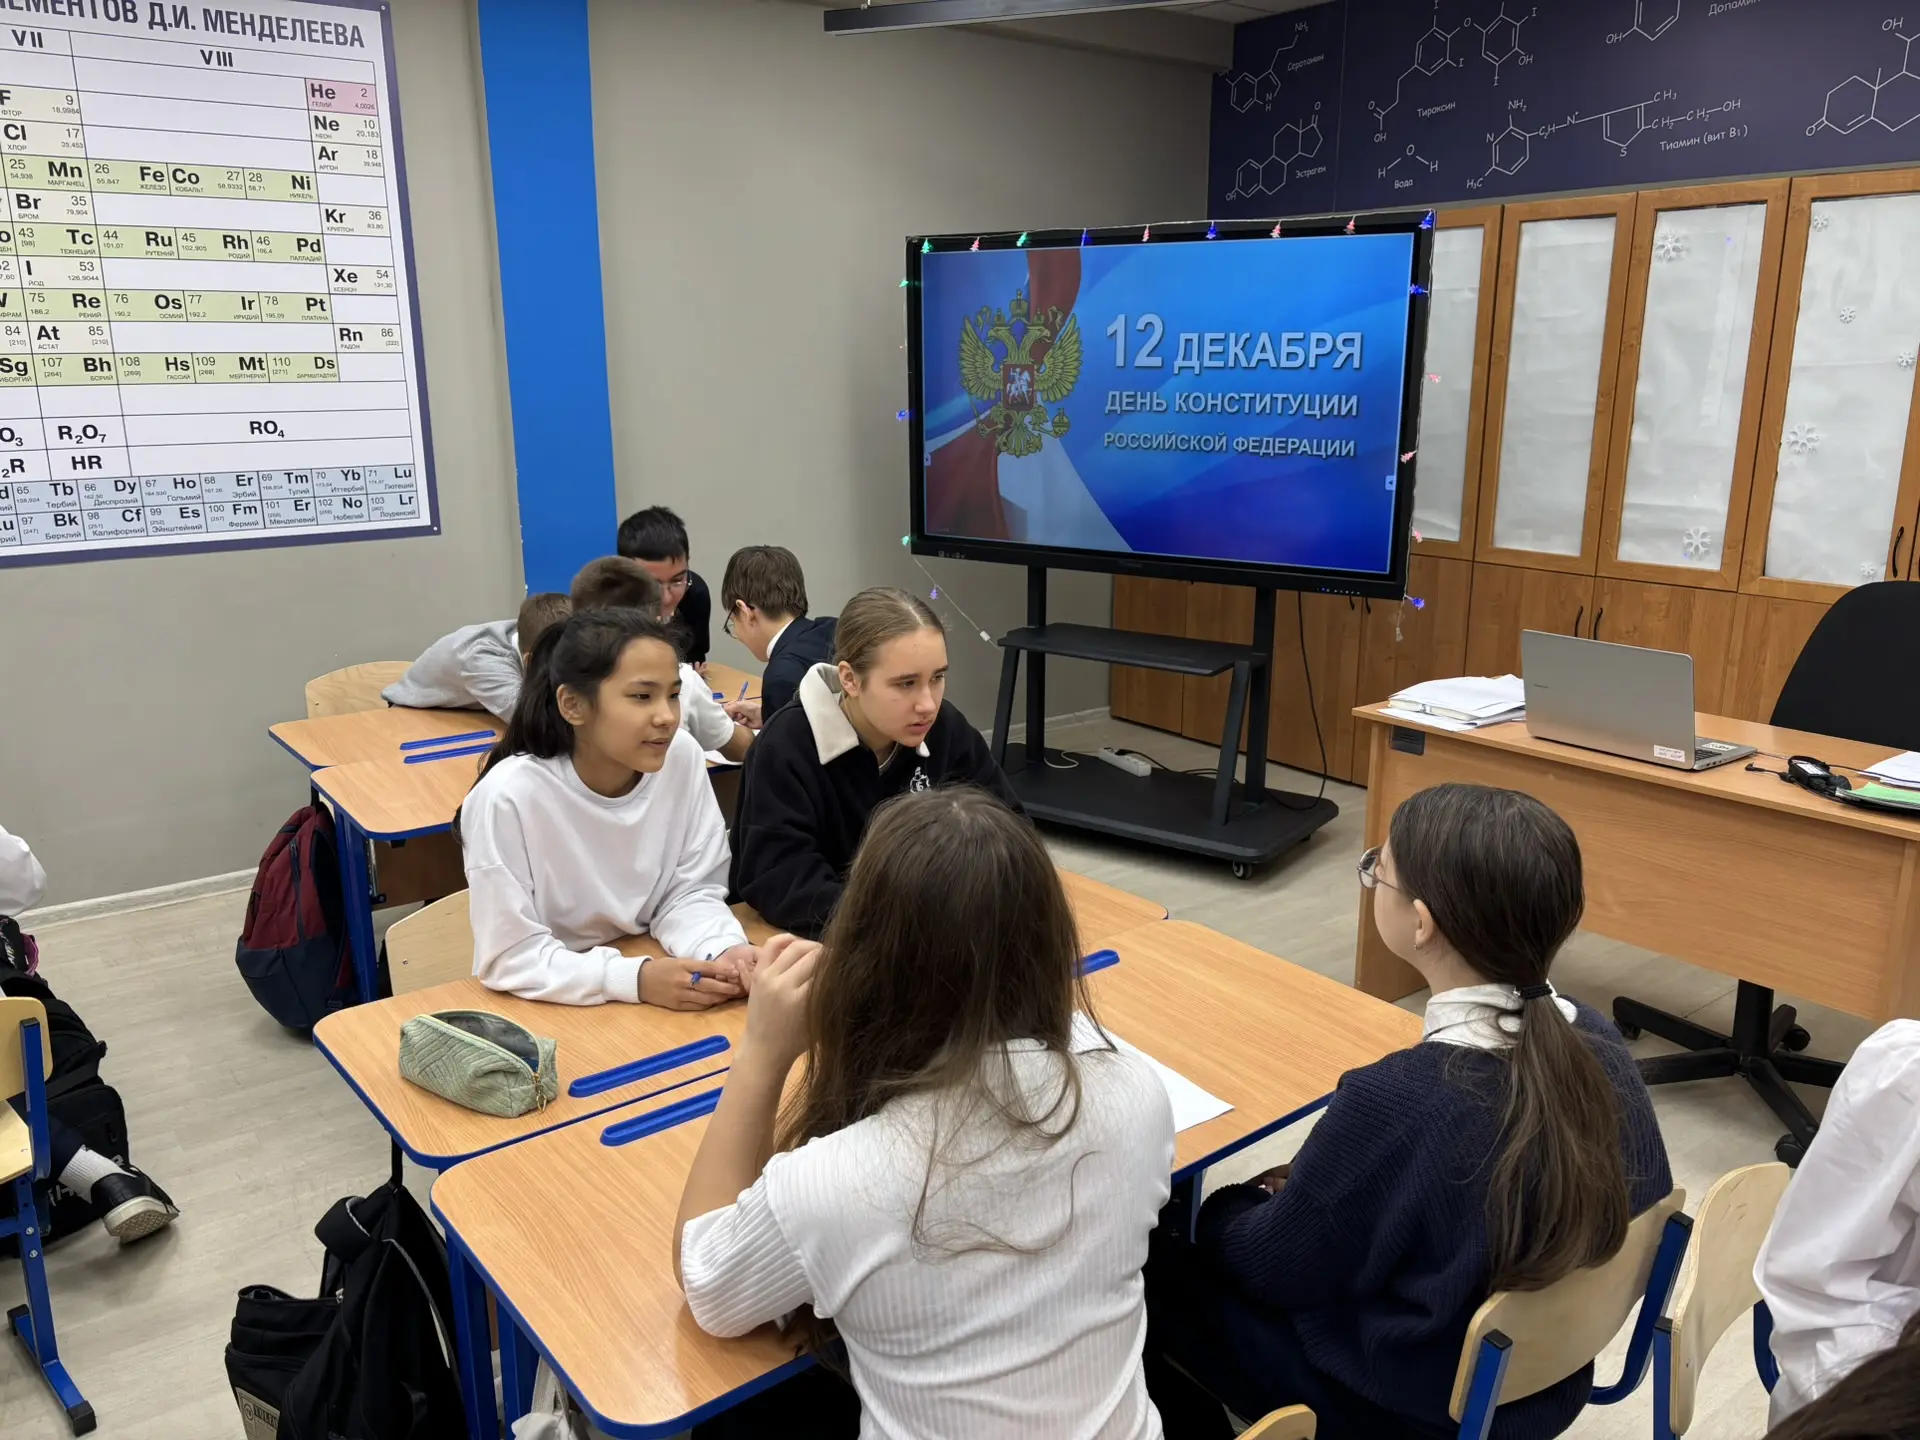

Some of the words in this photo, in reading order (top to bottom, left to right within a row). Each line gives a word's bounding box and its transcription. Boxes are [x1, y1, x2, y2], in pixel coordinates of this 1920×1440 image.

[1708, 0, 1761, 16] Допами
[149, 2, 196, 31] Д.И.
[203, 8, 364, 48] МЕНДЕЛЕЕВА
[1882, 17, 1903, 30] OH
[12, 30, 43, 48] VII
[1605, 33, 1623, 44] OH
[200, 50, 233, 67] VIII
[1518, 55, 1533, 65] OH
[0, 90, 11, 105] F
[66, 95, 74, 106] 9
[310, 83, 336, 100] He
[360, 88, 368, 98] 2
[1417, 101, 1456, 118] Тироксин
[314, 116, 340, 132] Ne
[363, 120, 375, 129] 10
[4, 124, 27, 141] Cl
[66, 129, 80, 139] 17
[1659, 136, 1700, 151] Тиамин
[1703, 132, 1726, 144] (вит
[318, 147, 338, 161] Ar
[366, 150, 378, 159] 18
[9, 159, 26, 169] 25
[48, 161, 82, 178] Mn
[94, 164, 110, 174] 26
[139, 167, 165, 182] Fe
[172, 168, 200, 184] Co
[226, 171, 240, 181] 27
[249, 172, 263, 182] 28
[292, 175, 310, 190] Ni
[48, 180, 85, 188] МАРГАНЕЦ
[1394, 179, 1413, 189] Вода
[16, 194, 41, 209] Br
[71, 196, 86, 206] 35
[325, 209, 346, 223] Kr
[368, 211, 382, 220] 36
[18, 228, 34, 238] 43
[66, 229, 94, 245] Tc
[103, 230, 118, 240] 44
[145, 232, 172, 247] Ru
[182, 233, 196, 243] 45
[222, 234, 249, 250] Rh
[256, 236, 270, 246] 46
[296, 238, 322, 253] Pd
[79, 262, 94, 272] 53
[333, 268, 358, 283] Xe
[376, 270, 389, 279] 54
[29, 293, 45, 303] 75
[72, 293, 101, 308] Re
[113, 294, 129, 304] 76
[154, 294, 182, 310] Os
[188, 295, 202, 304] 77
[241, 296, 255, 310] Ir
[264, 296, 278, 305] 78
[306, 297, 326, 312] Pt
[5, 326, 21, 336] 84
[36, 326, 60, 340] At
[88, 326, 104, 336] 85
[339, 328, 363, 342] Rn
[381, 328, 394, 337] 86
[1105, 313, 1165, 368] 12
[1172, 331, 1364, 375] ДЕКАБРЯ
[0, 357, 28, 376] Sg
[41, 358, 63, 368] 107
[83, 357, 112, 372] Bh
[119, 357, 140, 366] 108
[164, 357, 190, 371] Hs
[195, 357, 216, 366] 109
[239, 357, 265, 371] Mt
[272, 357, 291, 366] 110
[314, 357, 335, 369] Ds
[1105, 390, 1168, 414] ДЕНЬ
[1174, 393, 1358, 419] КОНСТИТУЦИИ
[1103, 432, 1227, 452] РОССИЙСКОЙ
[1232, 436, 1356, 459] ФЕДЕРАЦИИ
[71, 456, 103, 470] HR
[261, 473, 273, 482] 69
[284, 472, 309, 484] Tm
[315, 472, 326, 480] 70
[340, 469, 361, 481] Yb
[394, 467, 412, 479] Lu
[84, 484, 96, 492] 66
[114, 480, 137, 494] Dy
[145, 479, 157, 488] 67
[173, 478, 196, 490] Ho
[204, 476, 216, 484] 68
[235, 474, 253, 487] Er
[384, 482, 414, 490] Лютеций
[16, 486, 30, 495] 65
[49, 483, 74, 496] Tb
[232, 490, 257, 499] Эрбий
[288, 487, 310, 496] Тулий
[331, 485, 364, 493] Иттербий
[93, 497, 138, 507] Диспрозий
[167, 493, 201, 501] Гольмий
[318, 499, 333, 508] 102
[342, 498, 363, 509] No
[370, 497, 385, 505] 103
[399, 494, 414, 506] Lr
[46, 500, 77, 509] Тербий
[208, 504, 225, 514] 100
[232, 503, 257, 515] Fm
[265, 501, 281, 510] 101
[294, 500, 311, 512] Er
[22, 517, 34, 525] 97
[54, 513, 79, 527] Bk
[87, 512, 100, 520] 98
[122, 509, 142, 522] Cf
[150, 508, 162, 516] 99
[179, 507, 201, 519] Es
[333, 512, 364, 521] Нобелий
[379, 509, 416, 518] Лоуренсий
[228, 519, 259, 528] Фермий
[269, 516, 316, 525] Менделевий
[92, 526, 145, 537] Калифорний
[152, 523, 203, 533] Эйнштейний
[45, 531, 81, 540] Берклий
